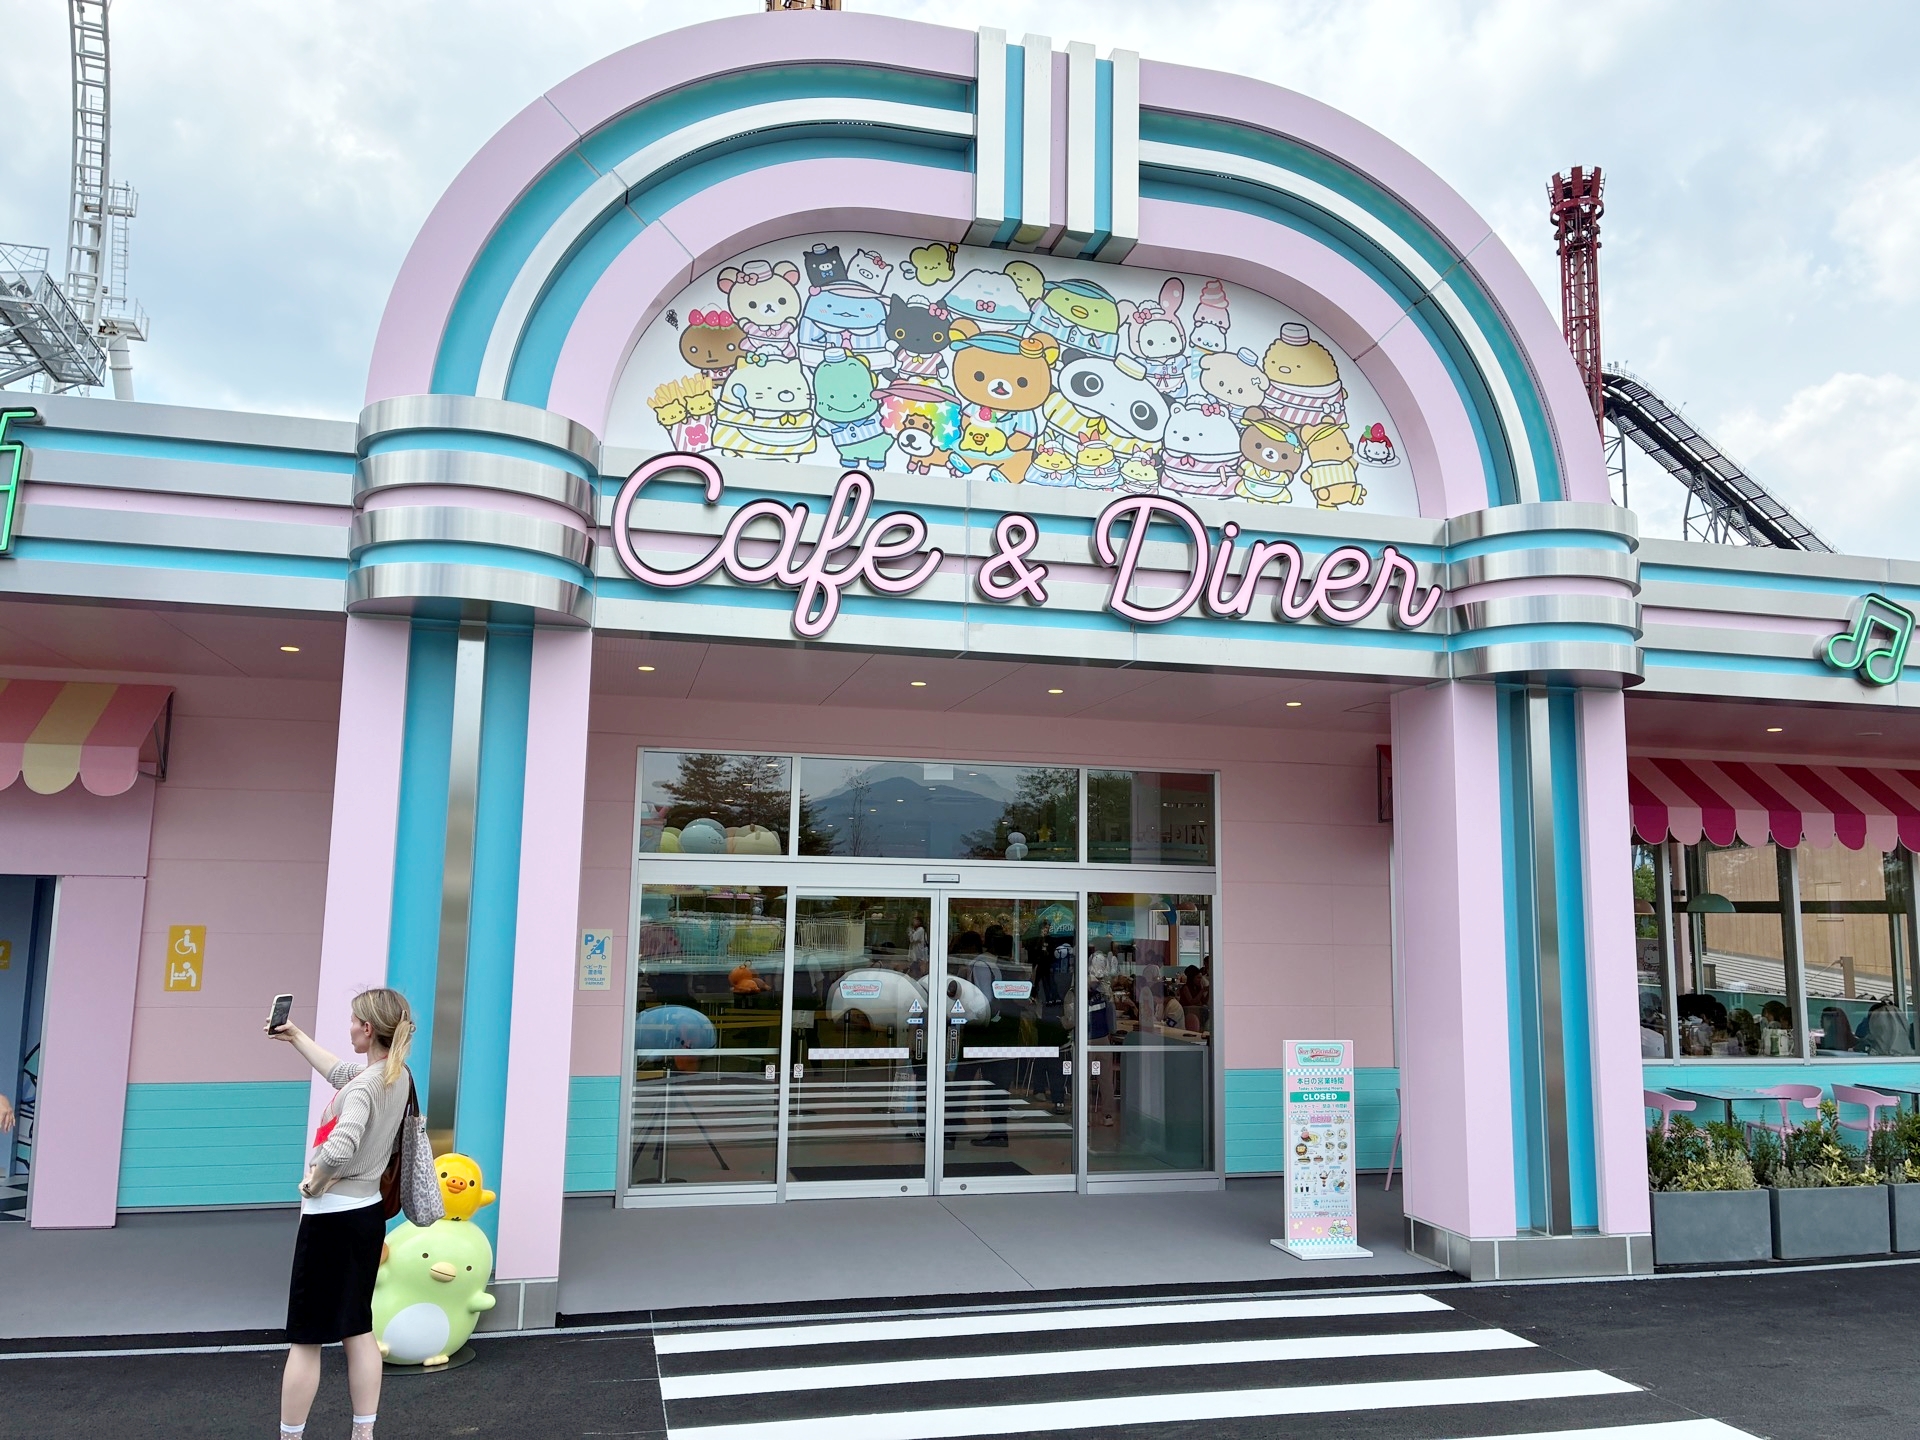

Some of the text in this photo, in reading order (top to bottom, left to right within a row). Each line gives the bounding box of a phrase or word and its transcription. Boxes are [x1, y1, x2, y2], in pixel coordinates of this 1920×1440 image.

[614, 450, 1441, 640] Cafe & Diner
